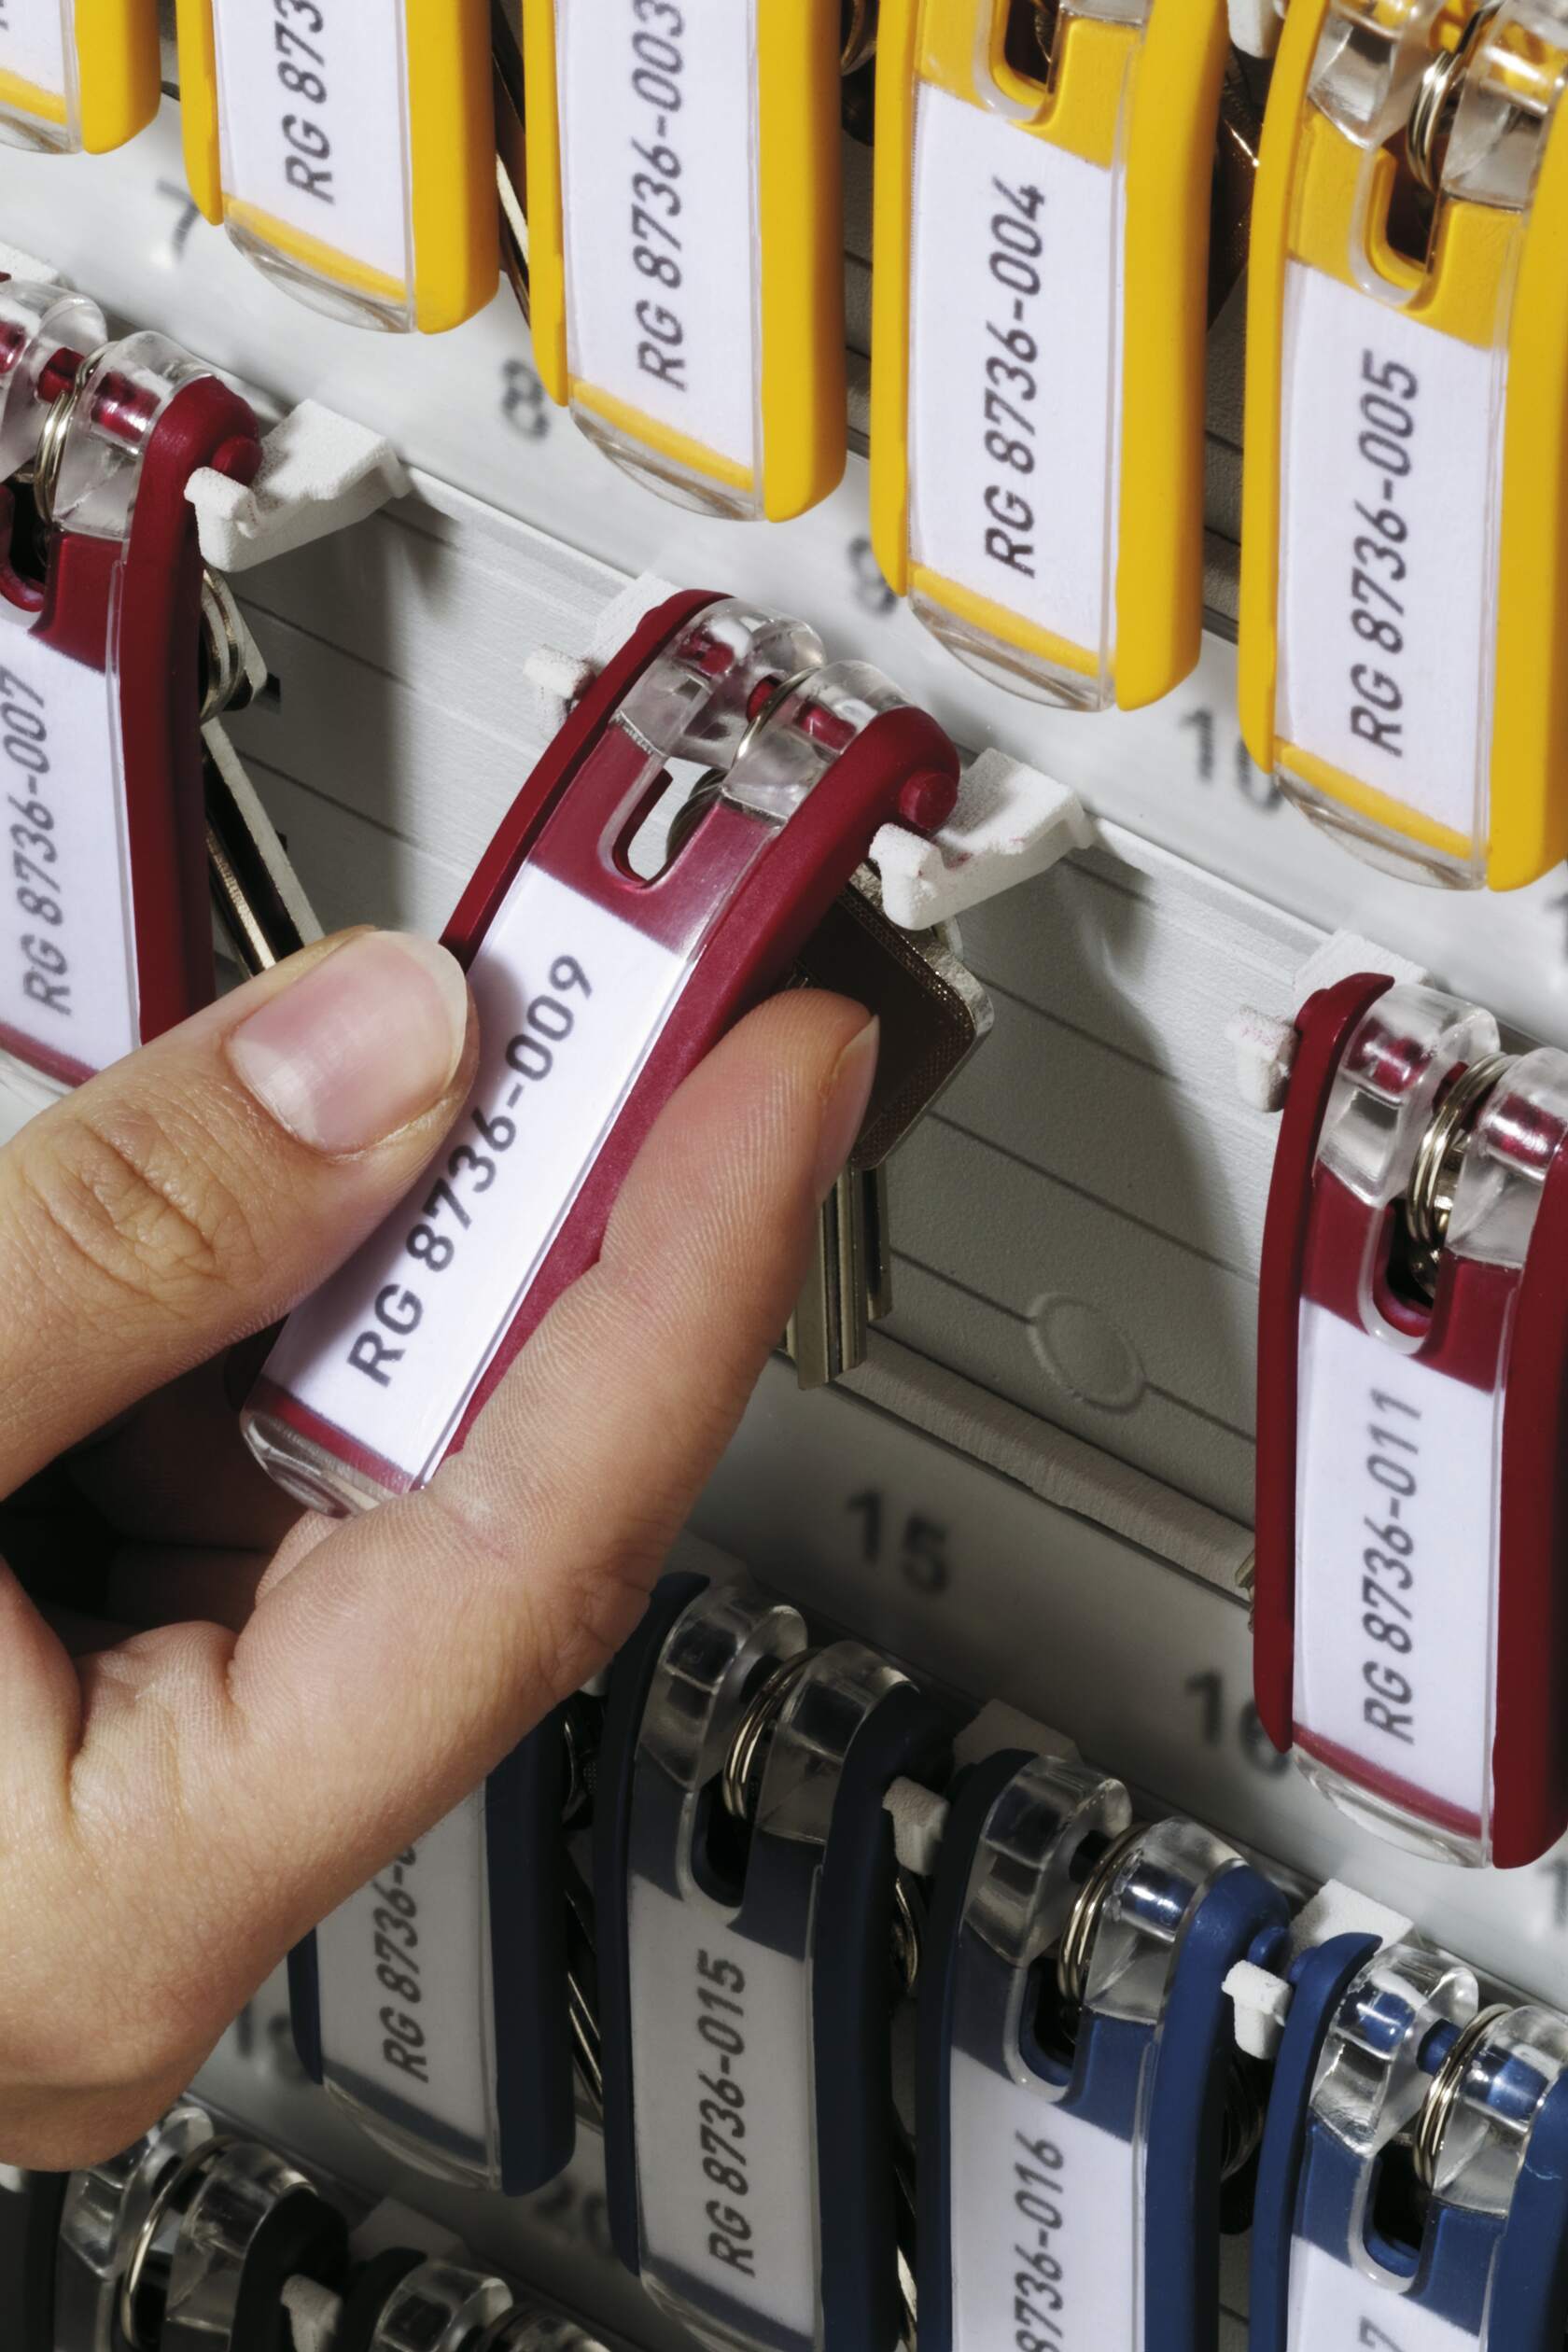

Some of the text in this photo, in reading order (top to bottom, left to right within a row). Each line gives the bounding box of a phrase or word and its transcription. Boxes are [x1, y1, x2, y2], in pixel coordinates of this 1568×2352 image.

[282, 114, 333, 204] RG
[632, 0, 686, 392] RG 8736-003
[502, 357, 550, 442] 8
[984, 177, 1045, 579] RG 8736-004
[1350, 349, 1420, 758] RG 8736-005
[0, 664, 72, 1016] RG 8736-007
[347, 953, 594, 1388] RG 8736-009
[847, 1490, 950, 1596] 15
[1361, 1388, 1421, 1744] RG 8736-011
[379, 2006, 429, 2084] RG
[696, 1949, 756, 2278] RG 8736-015
